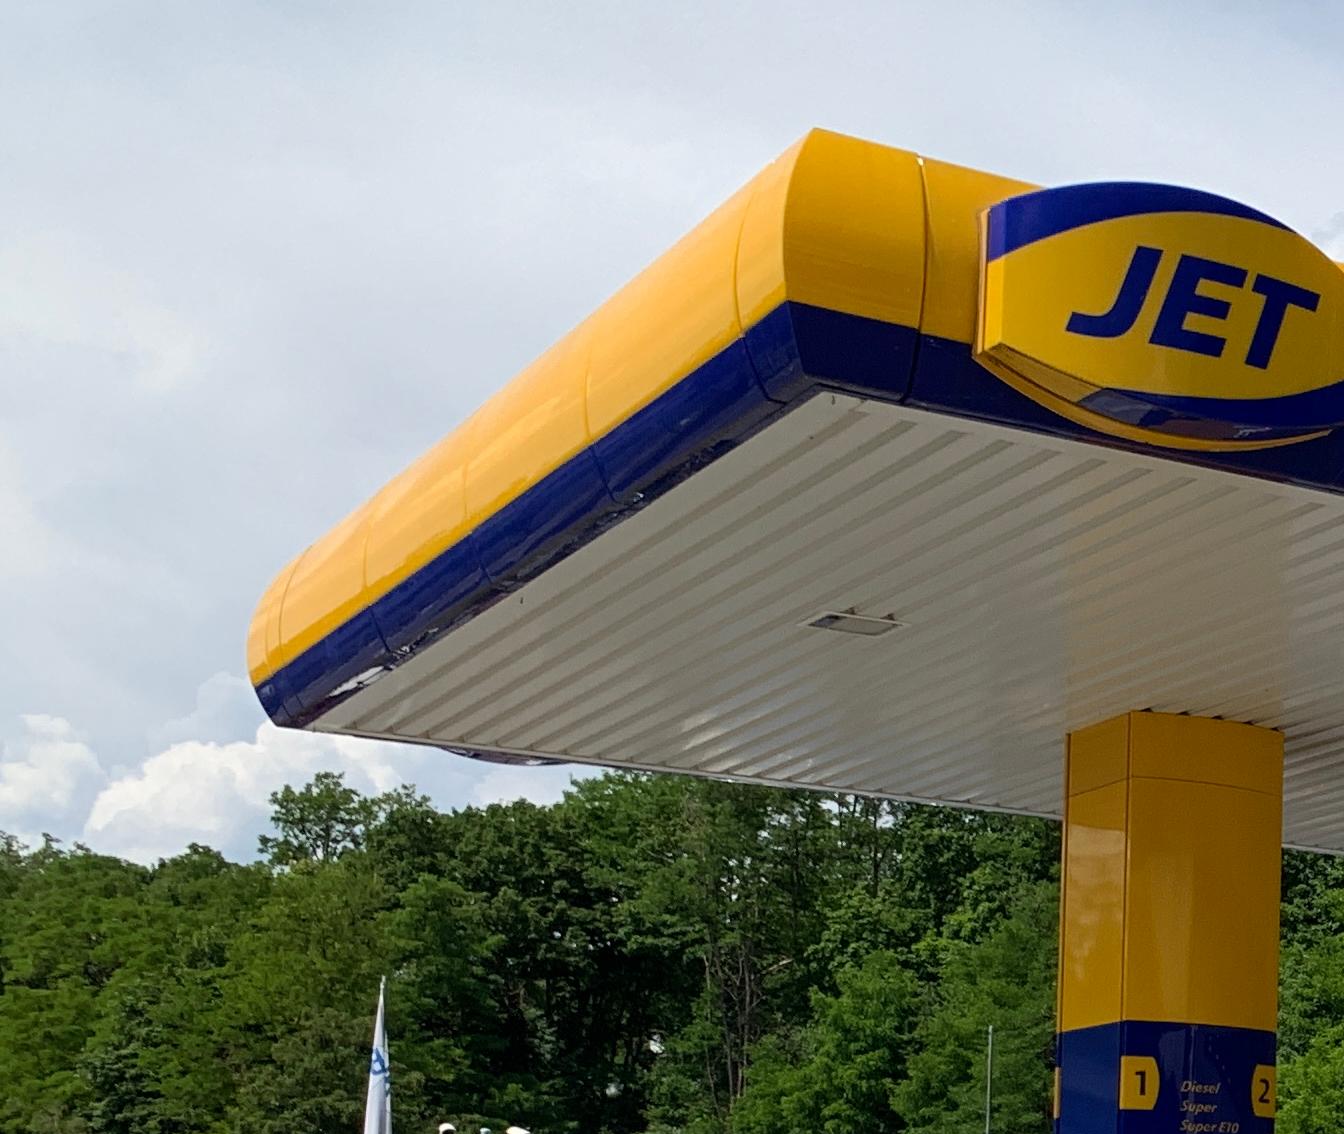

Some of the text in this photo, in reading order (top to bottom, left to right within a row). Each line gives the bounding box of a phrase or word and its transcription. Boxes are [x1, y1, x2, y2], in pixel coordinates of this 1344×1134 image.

[1065, 245, 1321, 370] JET
[1135, 1070, 1146, 1096] 1
[1180, 1081, 1221, 1094] Diesel
[1258, 1078, 1270, 1104] 2
[1180, 1101, 1217, 1115] Super
[1179, 1119, 1240, 1134] Super E10
